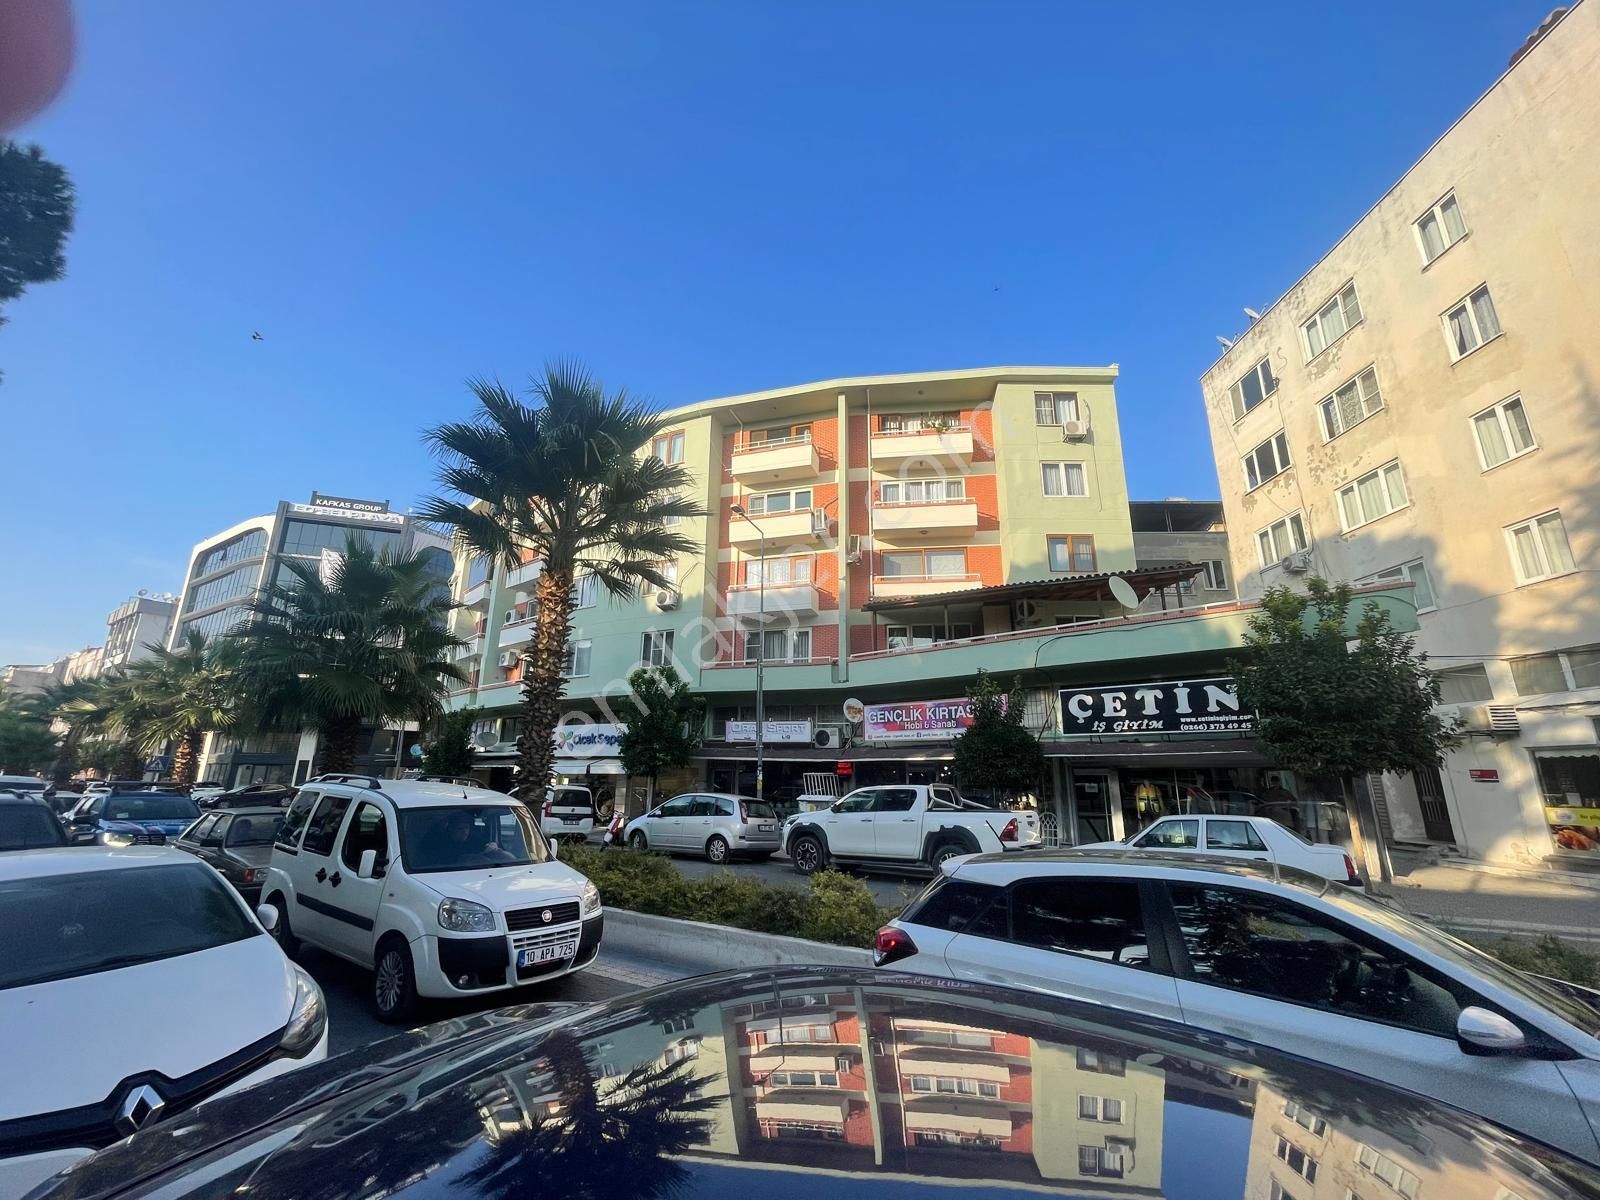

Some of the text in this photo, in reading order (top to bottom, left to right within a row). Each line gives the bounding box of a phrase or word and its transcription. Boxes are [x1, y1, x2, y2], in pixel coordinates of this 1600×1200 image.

[315, 498, 382, 512] KAFKAS GROUP
[1068, 681, 1240, 724] ÇETİN
[868, 705, 923, 725] GENÇLİK
[926, 705, 976, 720] KIRTAS
[731, 722, 757, 733] ORA
[904, 720, 957, 730] Hobi & Sanat
[1113, 719, 1164, 732] GİYİM
[526, 943, 573, 963] 10 APA 725
